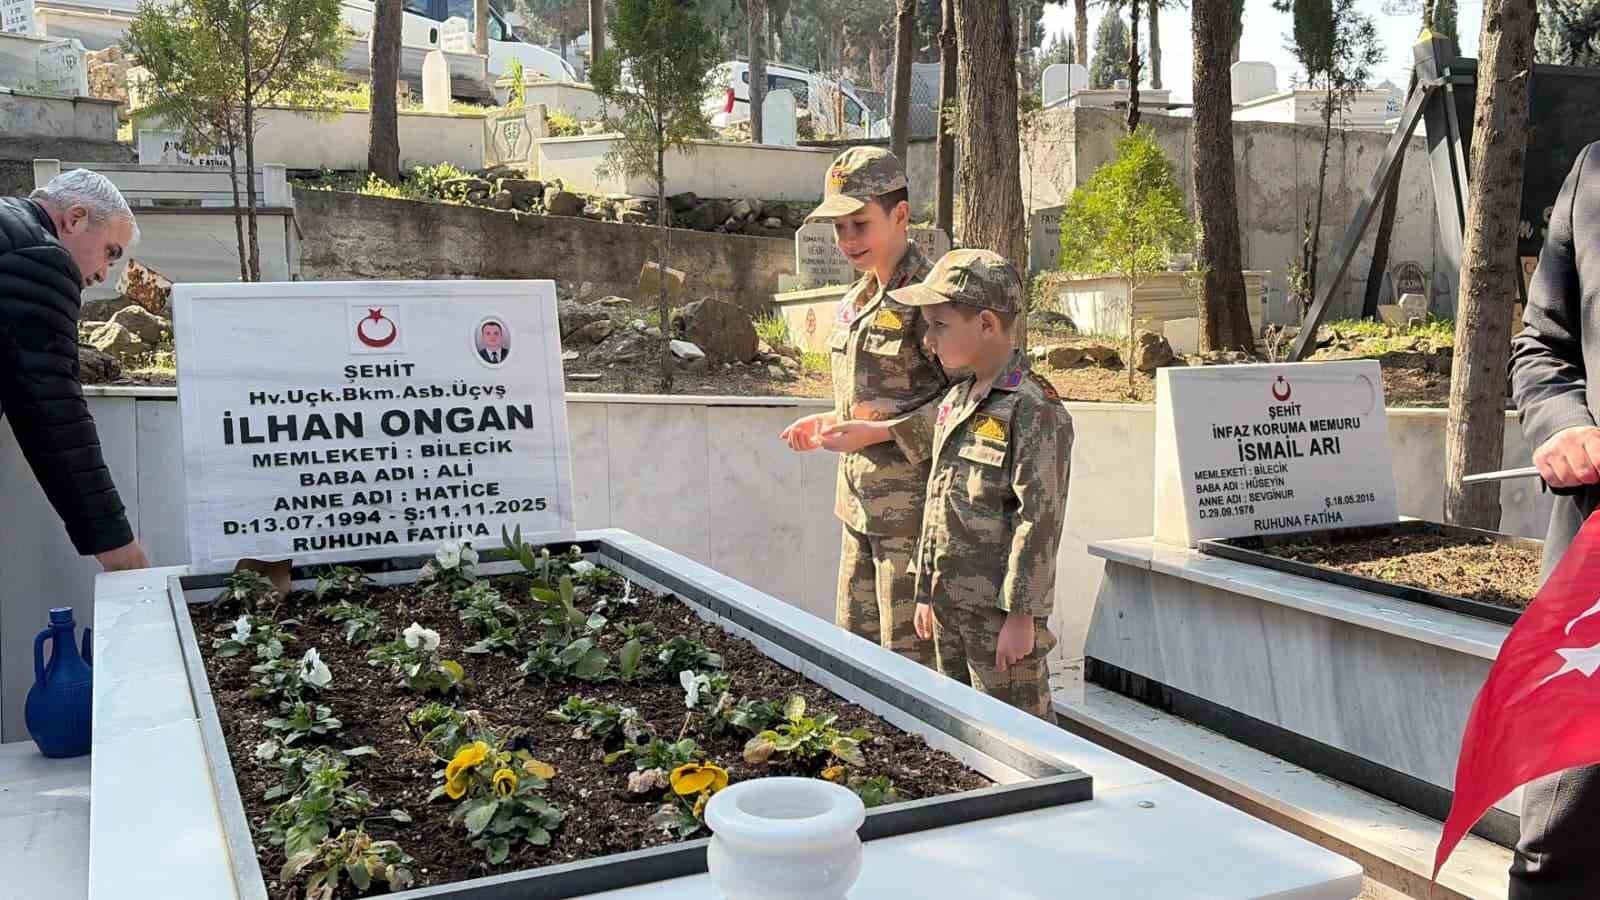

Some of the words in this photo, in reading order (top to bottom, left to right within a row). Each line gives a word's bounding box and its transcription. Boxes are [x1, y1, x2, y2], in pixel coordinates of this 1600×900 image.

[344, 360, 415, 383] ŞEHİT
[250, 379, 506, 407] Hv.Uçk.Bkm.Asb.Üçvş
[1268, 401, 1301, 420] ŞEHİT
[223, 411, 364, 445] İLHAN
[381, 404, 534, 437] ONGAN
[1212, 423, 1250, 439] İNFAZ
[1253, 419, 1307, 436] KORUMA
[1309, 417, 1361, 432] MEMURU
[252, 441, 397, 468] MEMLEKETİ
[420, 436, 513, 458] BİLECİK
[1237, 434, 1304, 462] İSMAİL
[1309, 436, 1341, 457] ARI
[299, 470, 367, 487] BABA
[375, 466, 414, 482] ADI
[437, 458, 473, 478] ALİ
[1194, 464, 1246, 480] MEMLEKETİ
[1254, 462, 1288, 475] BİLECİK
[274, 493, 343, 511] ANNE
[352, 489, 392, 506] ADI
[415, 480, 500, 501] HATİCE
[1196, 483, 1221, 494] BABA
[1223, 481, 1238, 491] ADI
[1246, 475, 1285, 489] HÜSEYİN
[1199, 495, 1224, 507] ANNE
[1226, 494, 1241, 505] ADI
[223, 510, 381, 535] D:13.07.1994
[404, 497, 547, 526] Ş:11.11.2025
[1254, 516, 1301, 531] RUHUNA
[1304, 509, 1343, 526] FATİHA
[293, 530, 399, 552] RUHUNA
